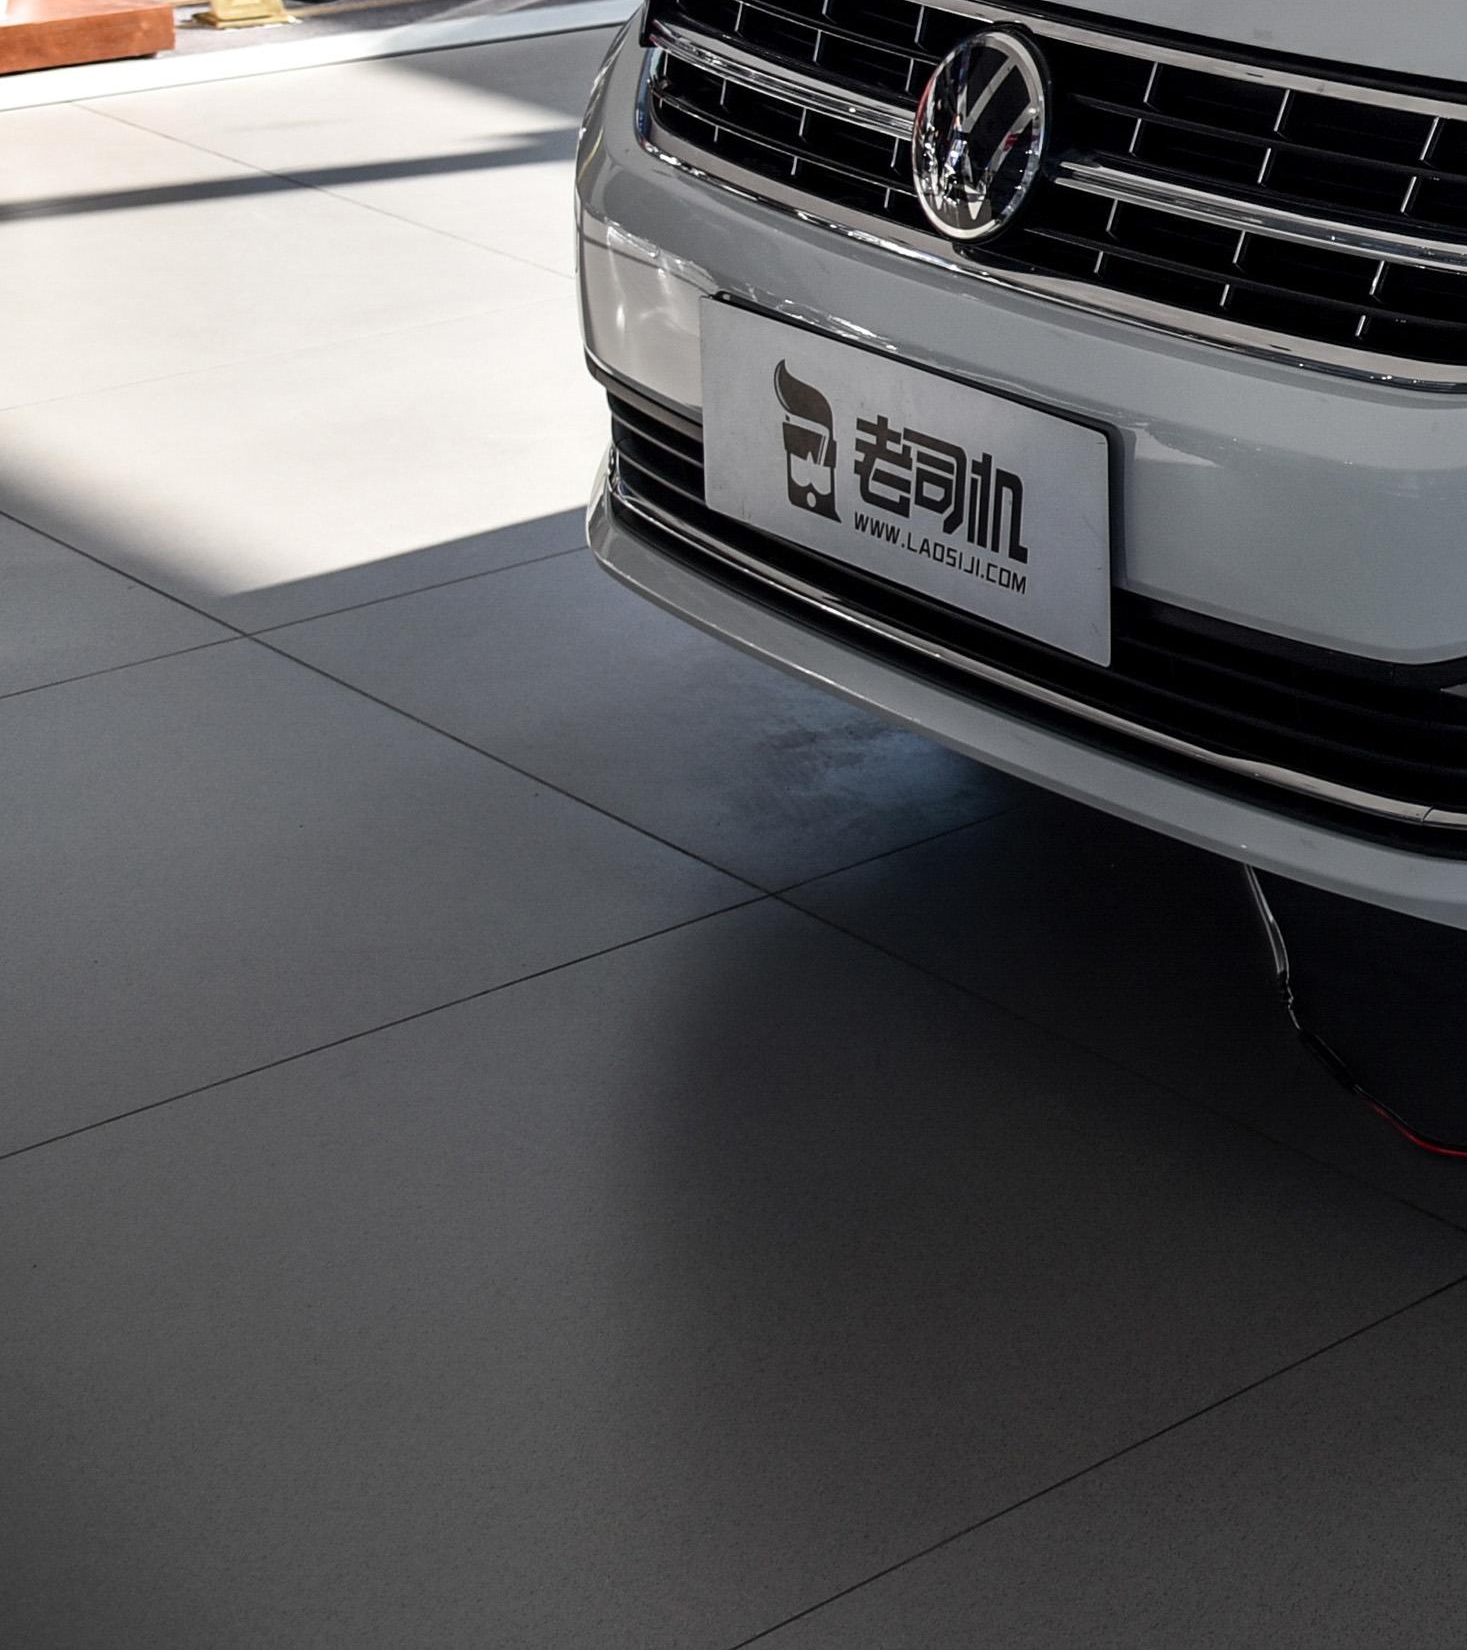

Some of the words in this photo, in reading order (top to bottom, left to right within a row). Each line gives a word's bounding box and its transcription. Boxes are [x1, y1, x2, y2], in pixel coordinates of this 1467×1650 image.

[853, 414, 1029, 565] 老司机
[854, 510, 1027, 595] WWW.LAOSIJI.COM
